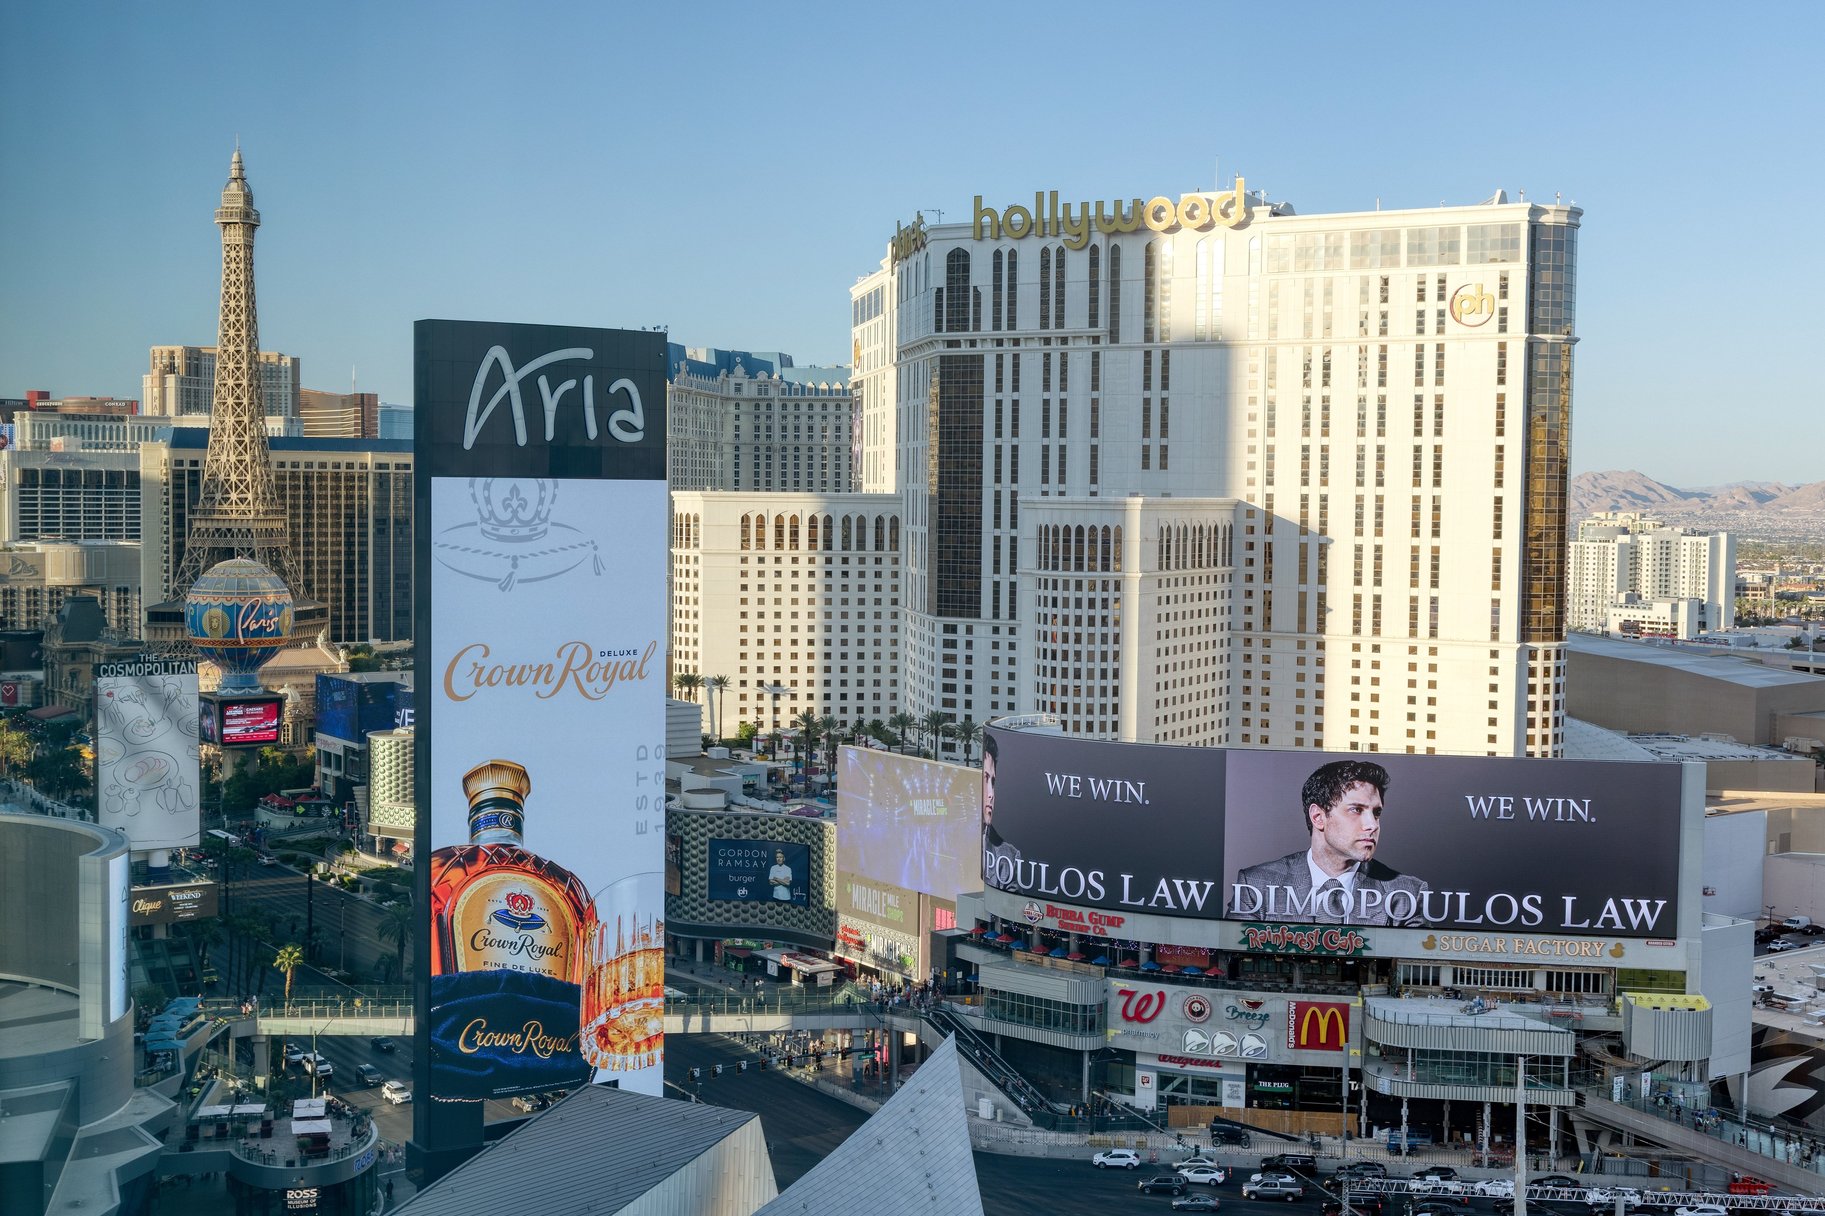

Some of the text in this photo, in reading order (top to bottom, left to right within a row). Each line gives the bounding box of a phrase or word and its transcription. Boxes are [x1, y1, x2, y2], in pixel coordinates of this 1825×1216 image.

[973, 177, 1245, 250] hollywood
[463, 345, 645, 451] Aria
[64, 414, 125, 422] VENETIAN
[238, 598, 279, 644] Paris
[139, 654, 158, 662] THE
[600, 649, 638, 657] DELUXE
[100, 662, 197, 677] COSMOPOLITAN
[443, 640, 657, 701] Crown Royal
[1045, 772, 1150, 805] WE WIN.
[1465, 795, 1597, 823] WE WIN.
[718, 849, 768, 858] GORDON
[718, 859, 767, 868] RAMSAY
[729, 874, 756, 884] burger
[985, 850, 1215, 911] POULOS LAW
[132, 899, 162, 916] Clique
[171, 892, 201, 901] WEEKEND
[852, 883, 887, 918] MIRACLE
[1231, 883, 1667, 931] DIMOPOULOS LAW
[1046, 904, 1086, 923] BUBBA
[1088, 911, 1126, 928] GUMP
[470, 928, 561, 961] Crown Royal
[1245, 925, 1321, 951] Rainforest
[1440, 935, 1606, 957] SUGAR FACTORY
[483, 960, 508, 968] FINE
[529, 966, 553, 976] LUXE
[1225, 1005, 1270, 1031] Breeze
[1288, 1001, 1296, 1049] McDonald's
[459, 1018, 523, 1054] Crown
[1158, 1054, 1223, 1068] Walgreens
[1272, 1081, 1289, 1089] PLUG
